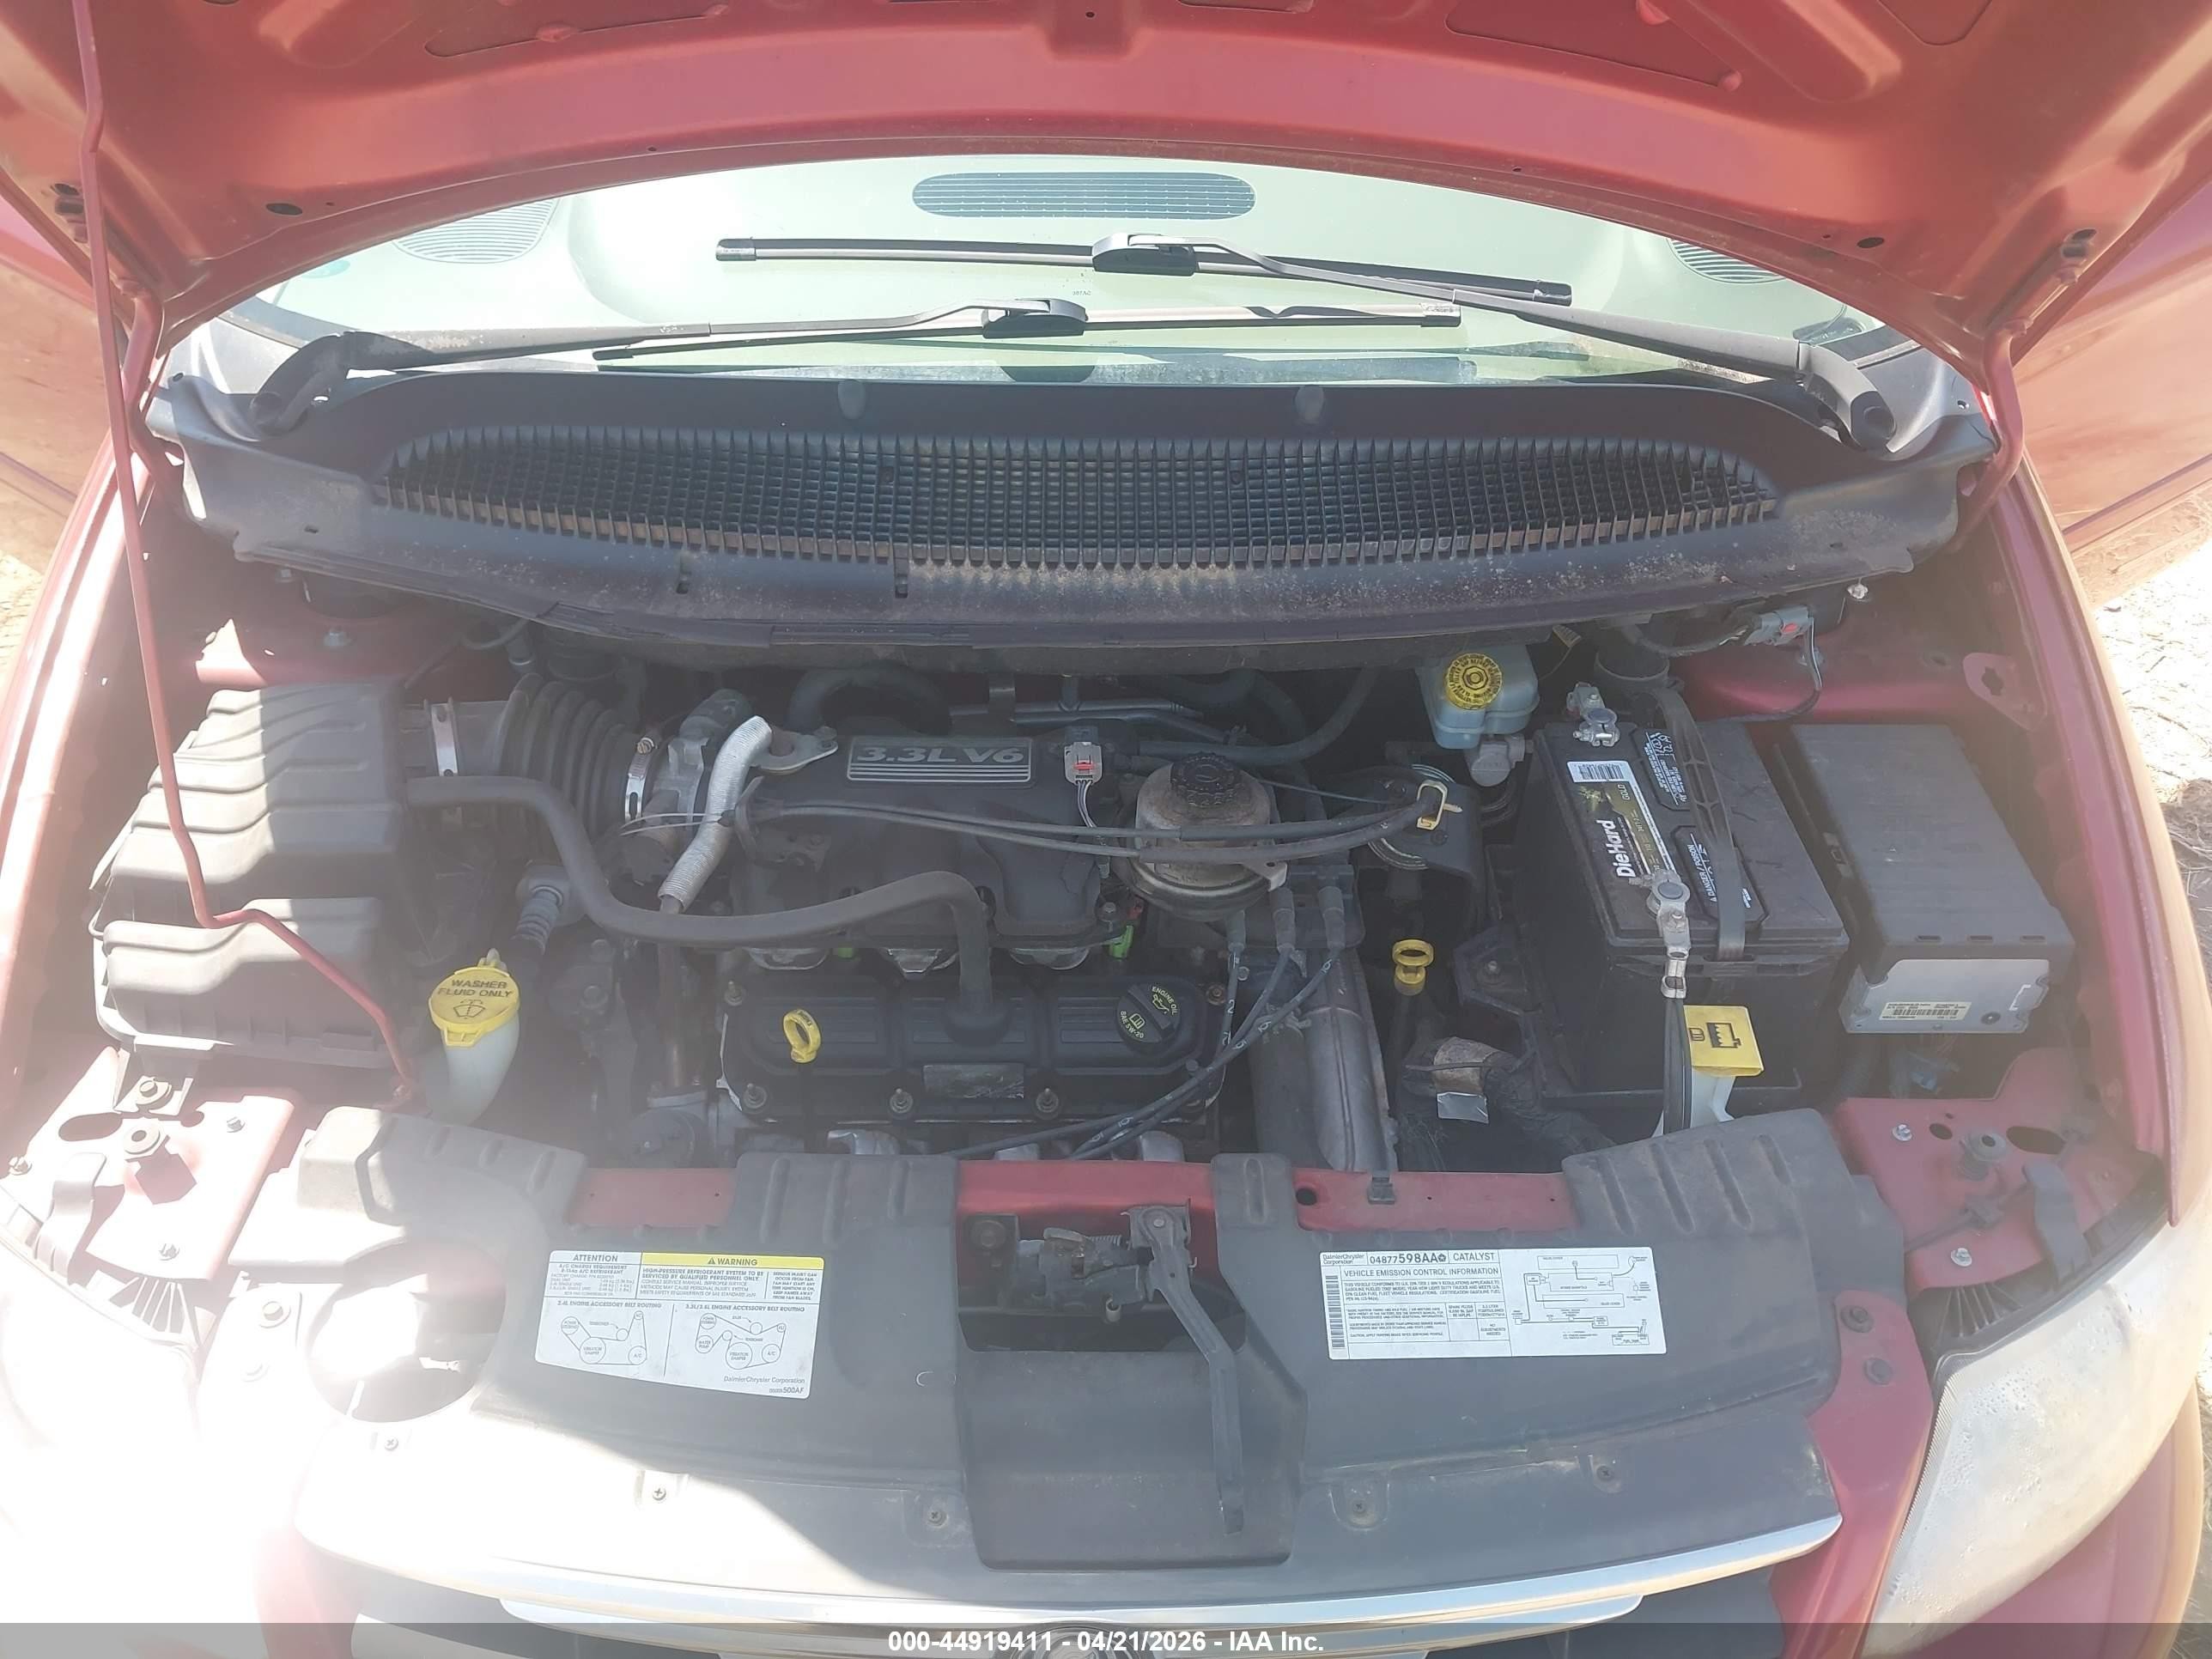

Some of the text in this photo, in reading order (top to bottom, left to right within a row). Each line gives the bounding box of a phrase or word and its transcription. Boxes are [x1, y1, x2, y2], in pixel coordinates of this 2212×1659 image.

[857, 747, 1024, 763] 3.3L V6
[1618, 784, 1630, 800] GOLD
[1596, 820, 1636, 878] DieHard
[1687, 844, 1703, 866] POISON
[1698, 872, 1716, 896] DANGER
[451, 979, 507, 989] WASHER
[438, 988, 514, 998] FLUID ONLY
[1152, 986, 1180, 1015] ENGINE OIL
[1126, 1023, 1145, 1038] 5W-20
[717, 1257, 757, 1267] WARNING
[1369, 1252, 1437, 1263] 04877598AA
[1452, 1252, 1495, 1261] CATALYST
[724, 1376, 770, 1384] DaimlerChrysler
